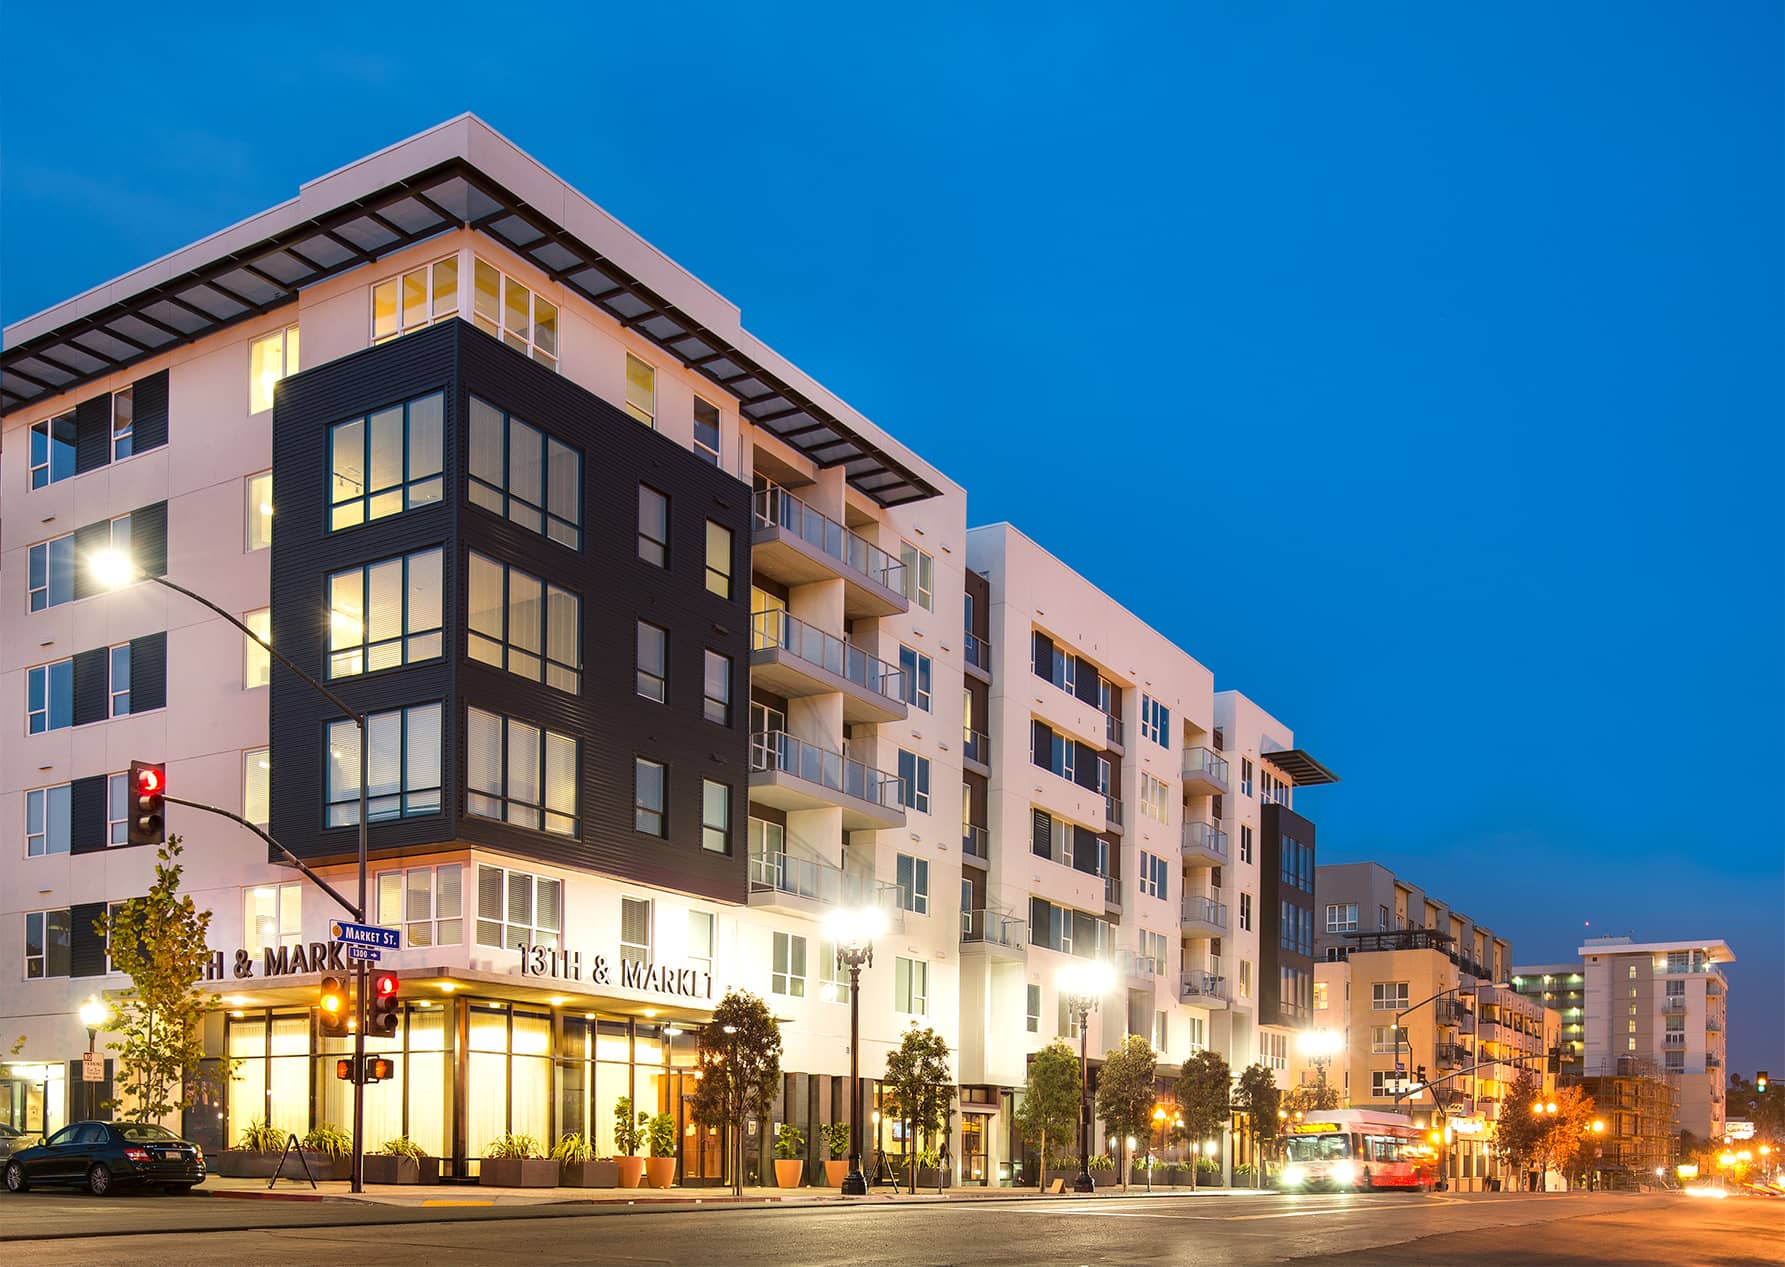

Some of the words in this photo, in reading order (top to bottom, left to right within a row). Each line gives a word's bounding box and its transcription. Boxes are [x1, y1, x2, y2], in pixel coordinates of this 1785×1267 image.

[345, 926, 380, 943] MARKET
[383, 932, 397, 946] ST.
[233, 949, 253, 978] &
[353, 948, 368, 958] 1300
[518, 943, 582, 980] 13TH
[592, 955, 610, 985] &
